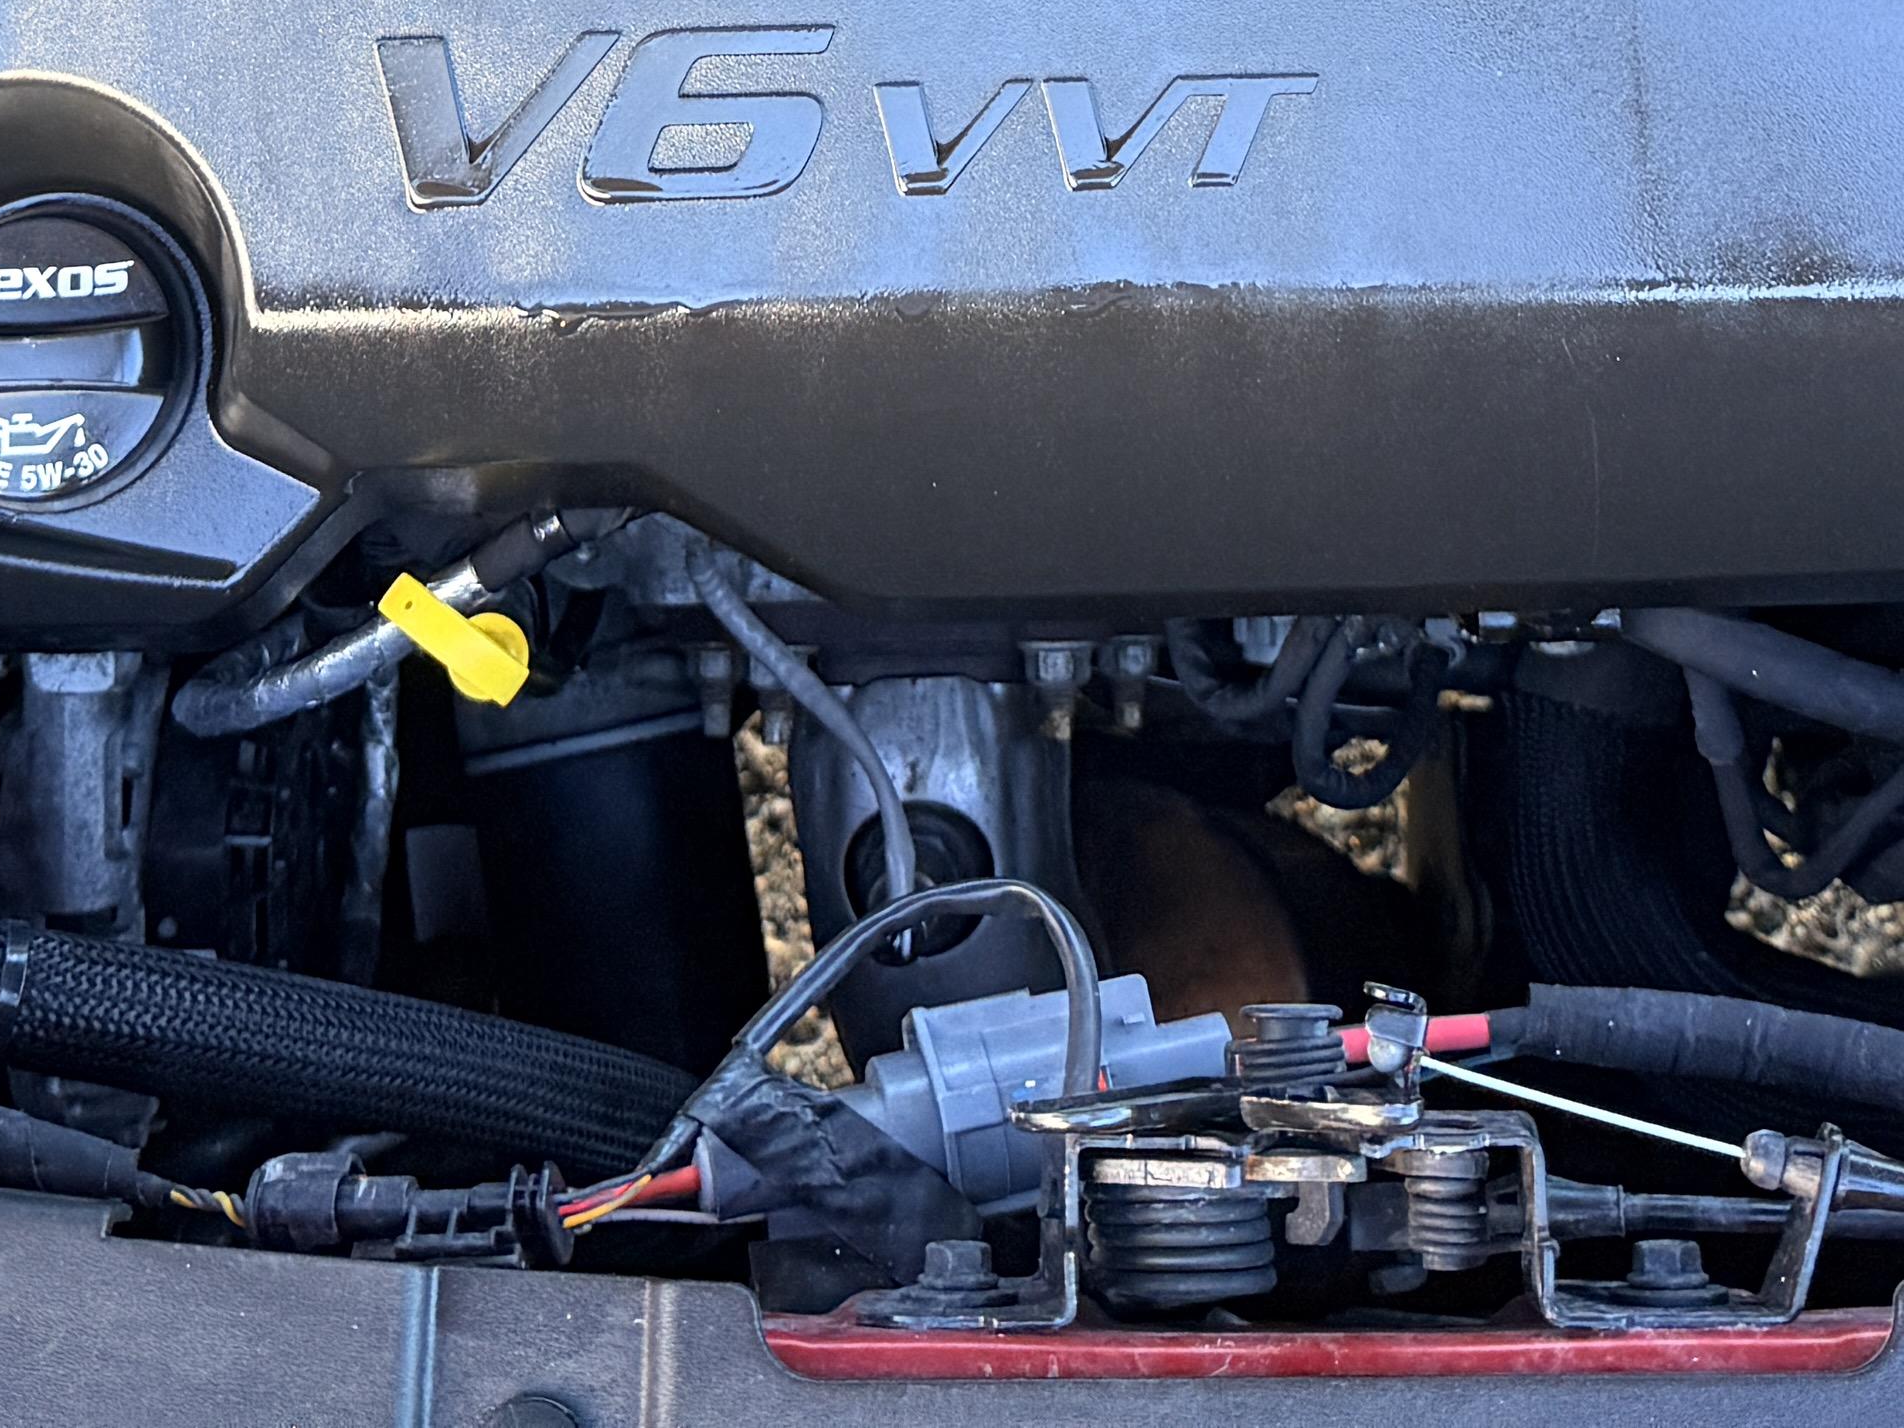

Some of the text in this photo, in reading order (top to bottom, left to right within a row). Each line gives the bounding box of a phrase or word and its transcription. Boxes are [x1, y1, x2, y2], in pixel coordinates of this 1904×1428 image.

[375, 24, 1319, 212] V6 VVT
[20, 443, 109, 491] 5W-30
